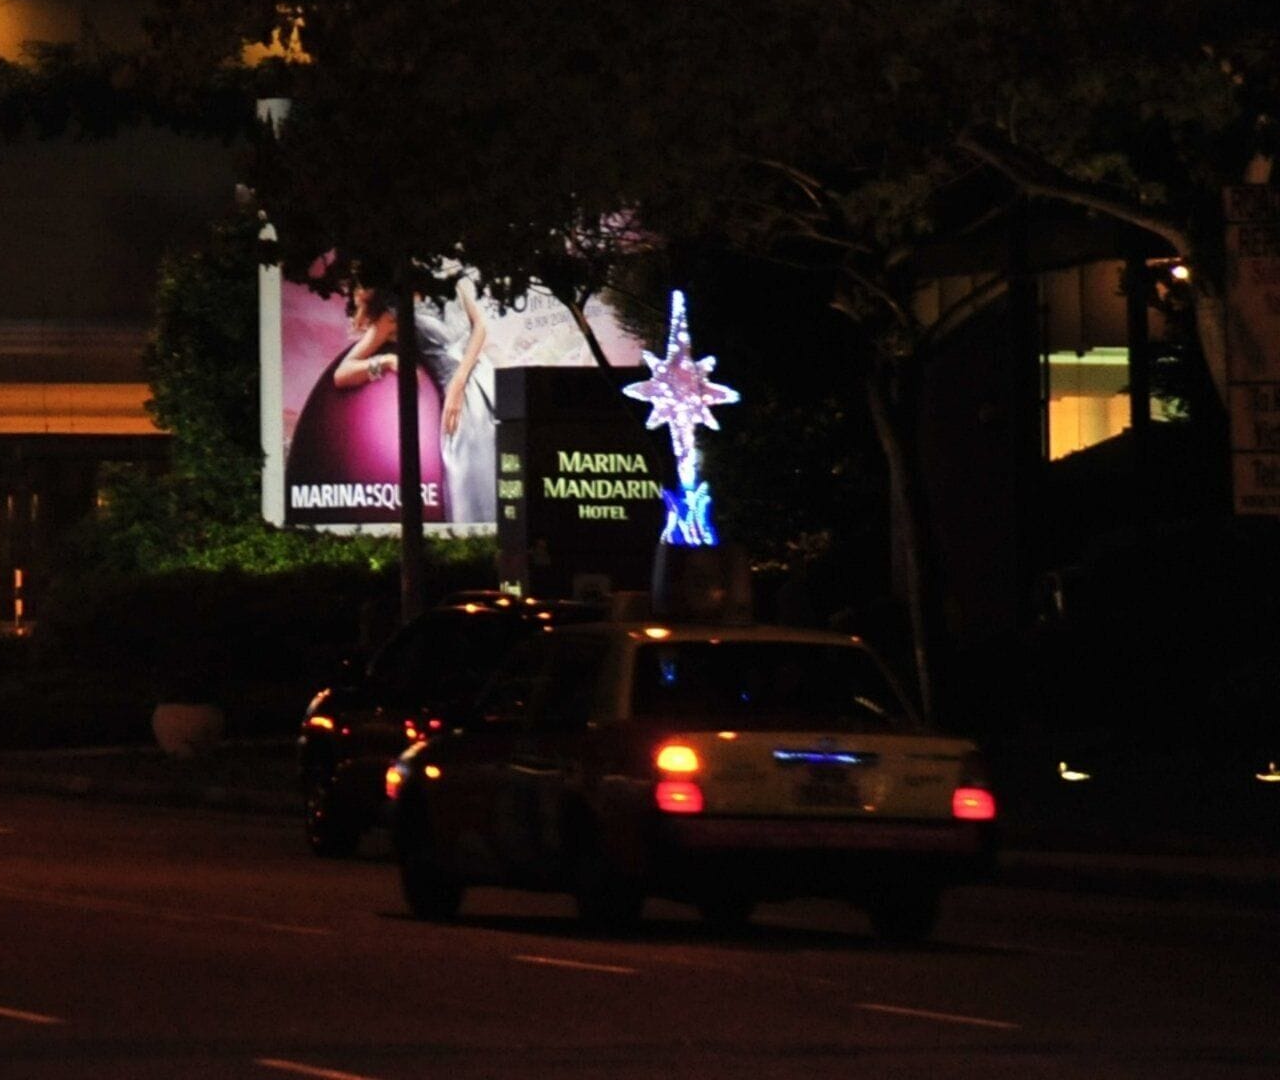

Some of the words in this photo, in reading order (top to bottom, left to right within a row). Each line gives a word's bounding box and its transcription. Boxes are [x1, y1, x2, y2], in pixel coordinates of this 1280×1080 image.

[556, 450, 648, 474] MARINA
[291, 482, 439, 511] MARINA:SQURE
[541, 476, 663, 500] MANDARIN
[578, 504, 628, 520] HOTEL
